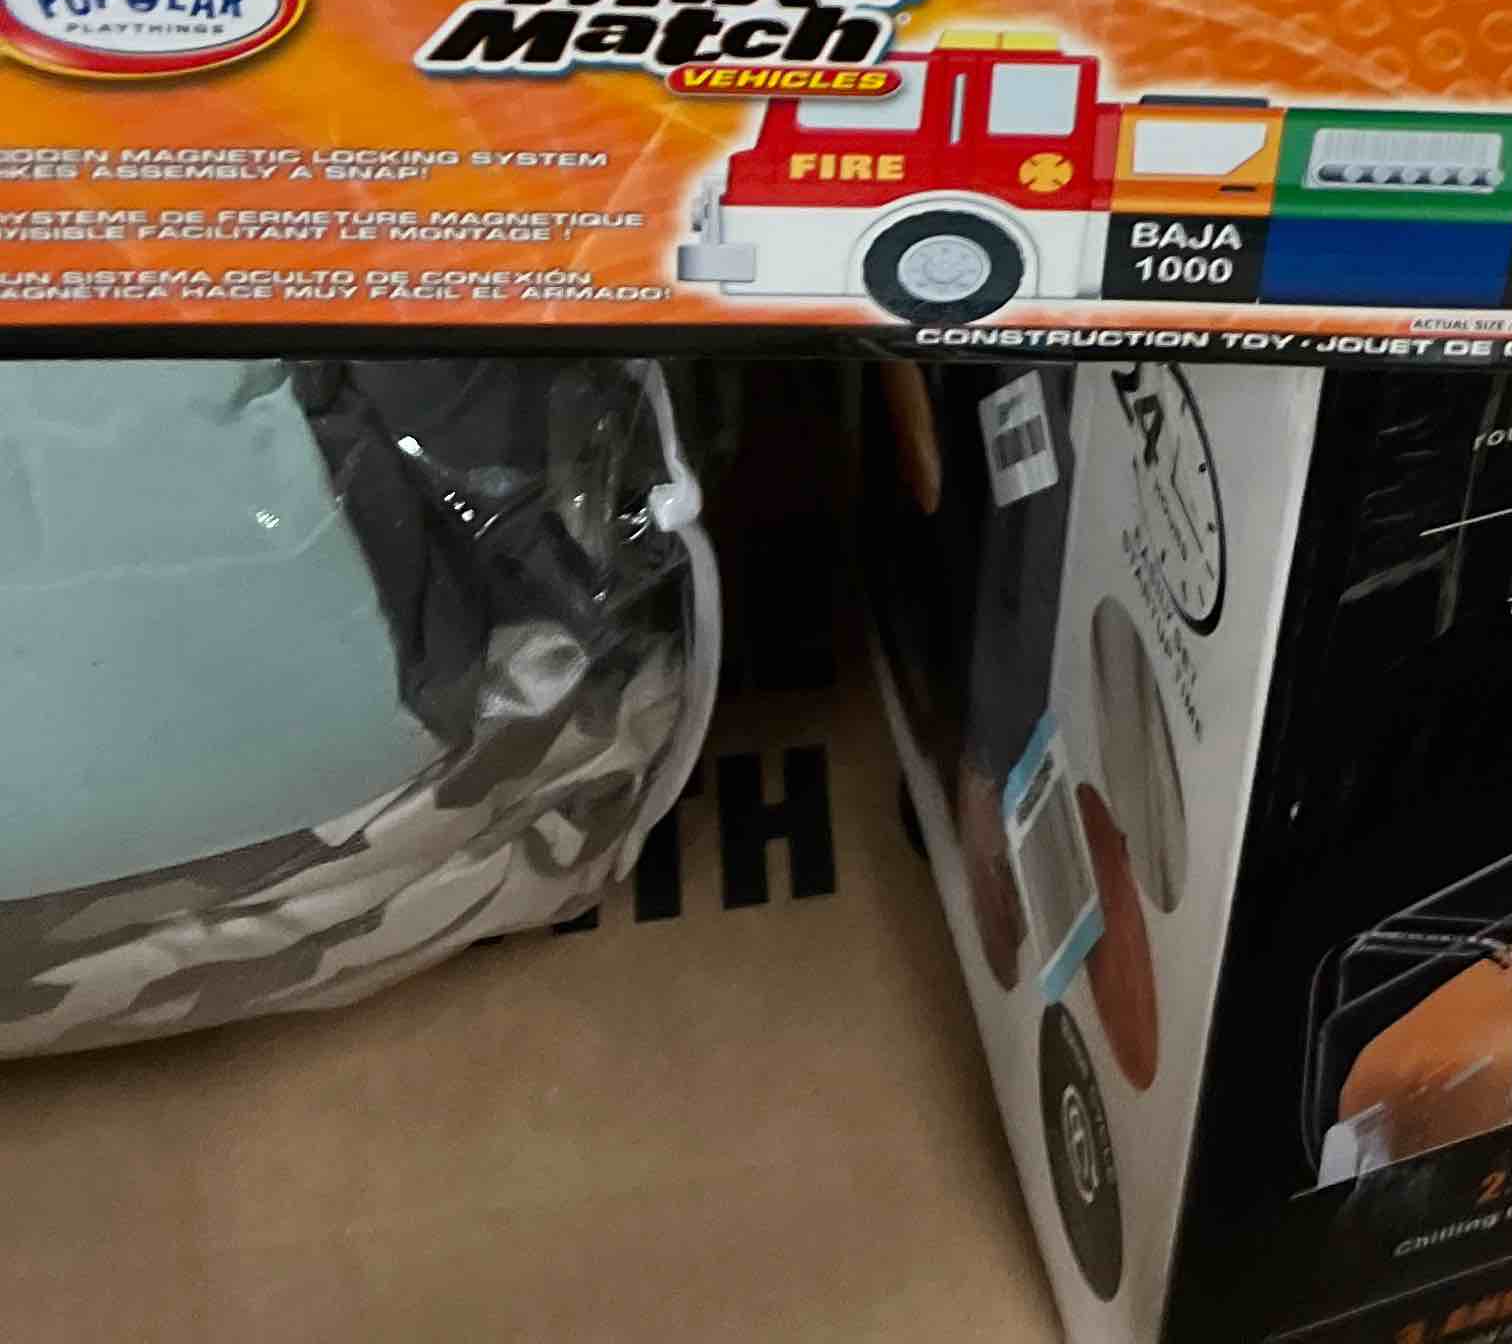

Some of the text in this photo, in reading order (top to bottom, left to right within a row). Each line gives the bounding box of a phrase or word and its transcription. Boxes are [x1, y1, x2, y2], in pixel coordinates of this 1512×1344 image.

[64, 22, 226, 35] PLAYTHINGS
[428, 7, 882, 66] Match
[681, 68, 889, 90] VEHICLES
[120, 148, 301, 163] MAGNETIC
[312, 150, 460, 165] LOCKING
[471, 152, 609, 167] SYSTEM
[91, 164, 280, 180] ASSEMBLY
[288, 165, 313, 180] A
[324, 165, 430, 180] SNAP!
[787, 153, 906, 182] FIRE
[158, 210, 206, 225] DE
[217, 210, 418, 226] FERMETURE
[137, 226, 330, 240] FACILITANT
[339, 227, 385, 240] LE
[388, 227, 551, 241] MONTAGE
[1130, 222, 1244, 251] BAJA
[62, 270, 213, 286] SISTEMA
[223, 270, 355, 286] OCULTO
[365, 271, 411, 286] DE
[1134, 255, 1235, 284] 1000
[180, 286, 274, 300] HACE
[284, 286, 359, 300] MUY
[471, 286, 509, 300] EL
[519, 286, 673, 301] ARMADO!
[1412, 318, 1469, 331] ACTUAL
[1473, 318, 1505, 331] SIZE
[915, 327, 1210, 350] CONSTRUCTION
[1219, 331, 1294, 352] TOY
[1315, 335, 1432, 358] JOUET
[1443, 339, 1492, 358] DE
[1394, 1211, 1502, 1258] Chilling
